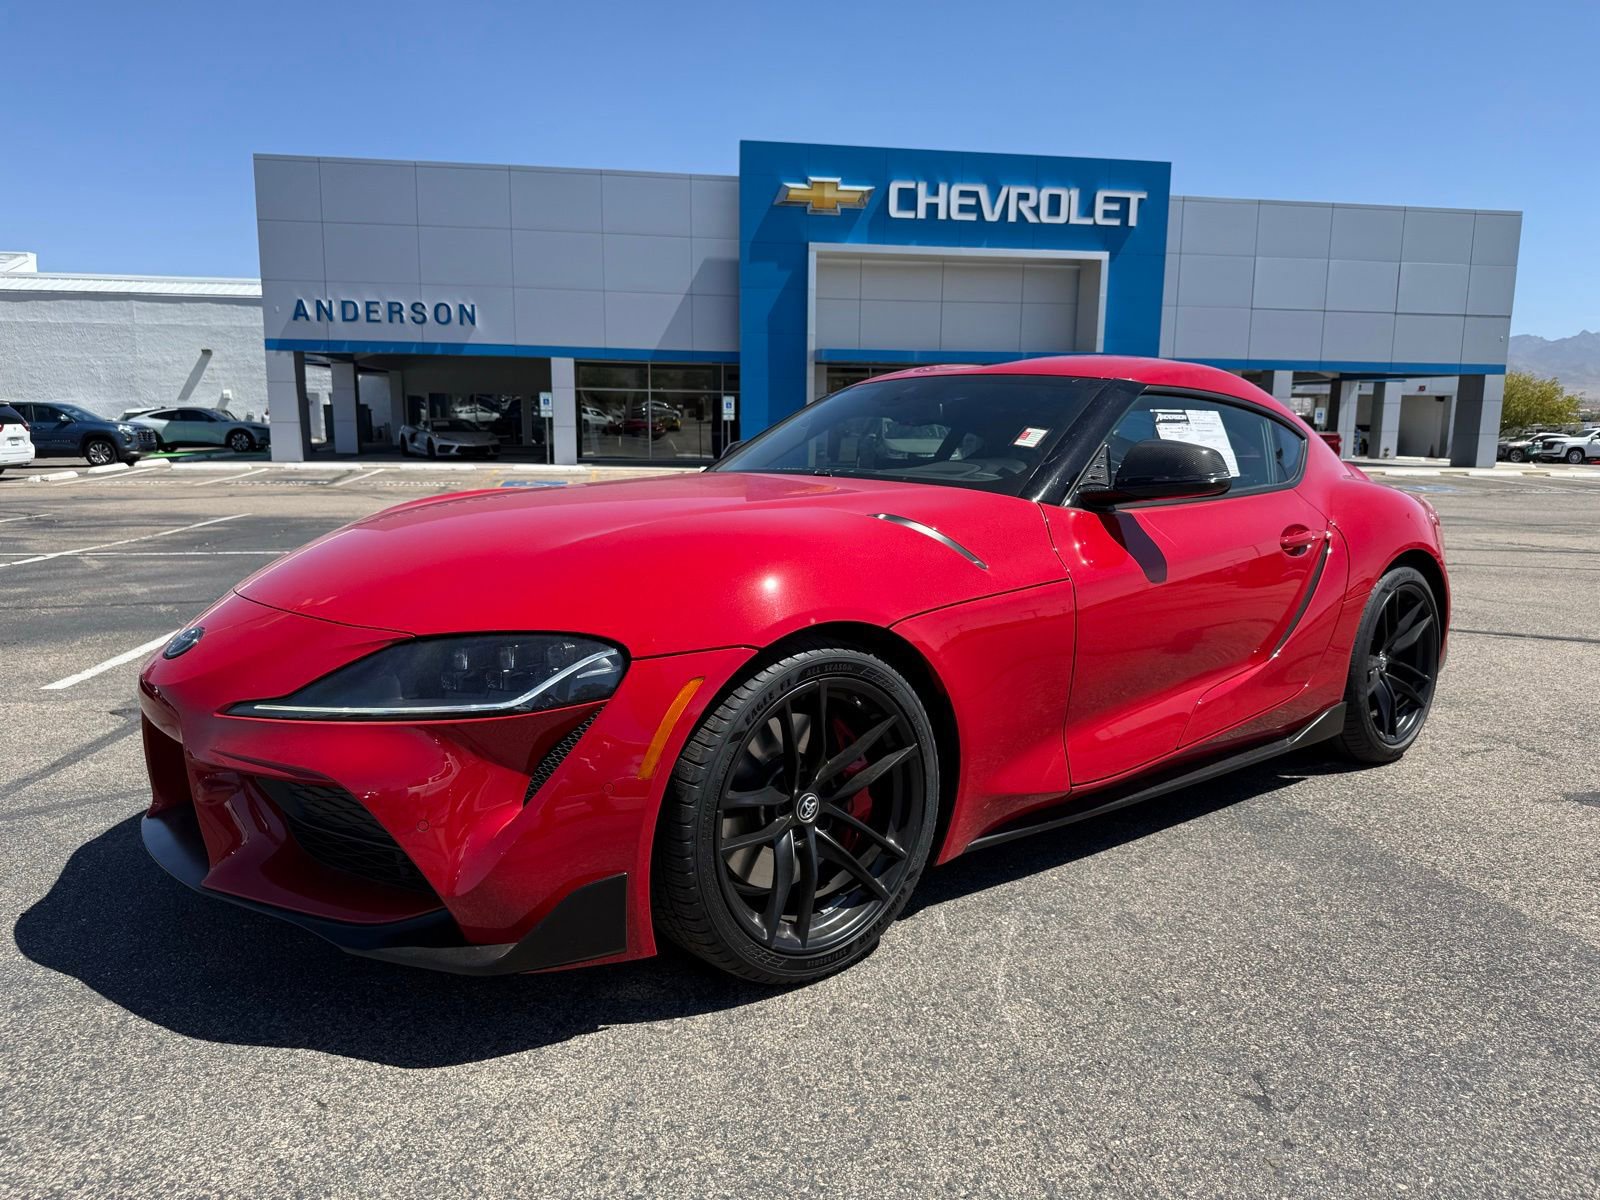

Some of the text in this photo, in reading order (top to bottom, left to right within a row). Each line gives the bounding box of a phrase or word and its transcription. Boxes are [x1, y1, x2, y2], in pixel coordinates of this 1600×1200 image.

[888, 179, 1147, 227] CHEVROLET
[292, 298, 477, 326] ANDERSON
[823, 664, 854, 672] SEASON
[745, 690, 775, 726] EAGLE
